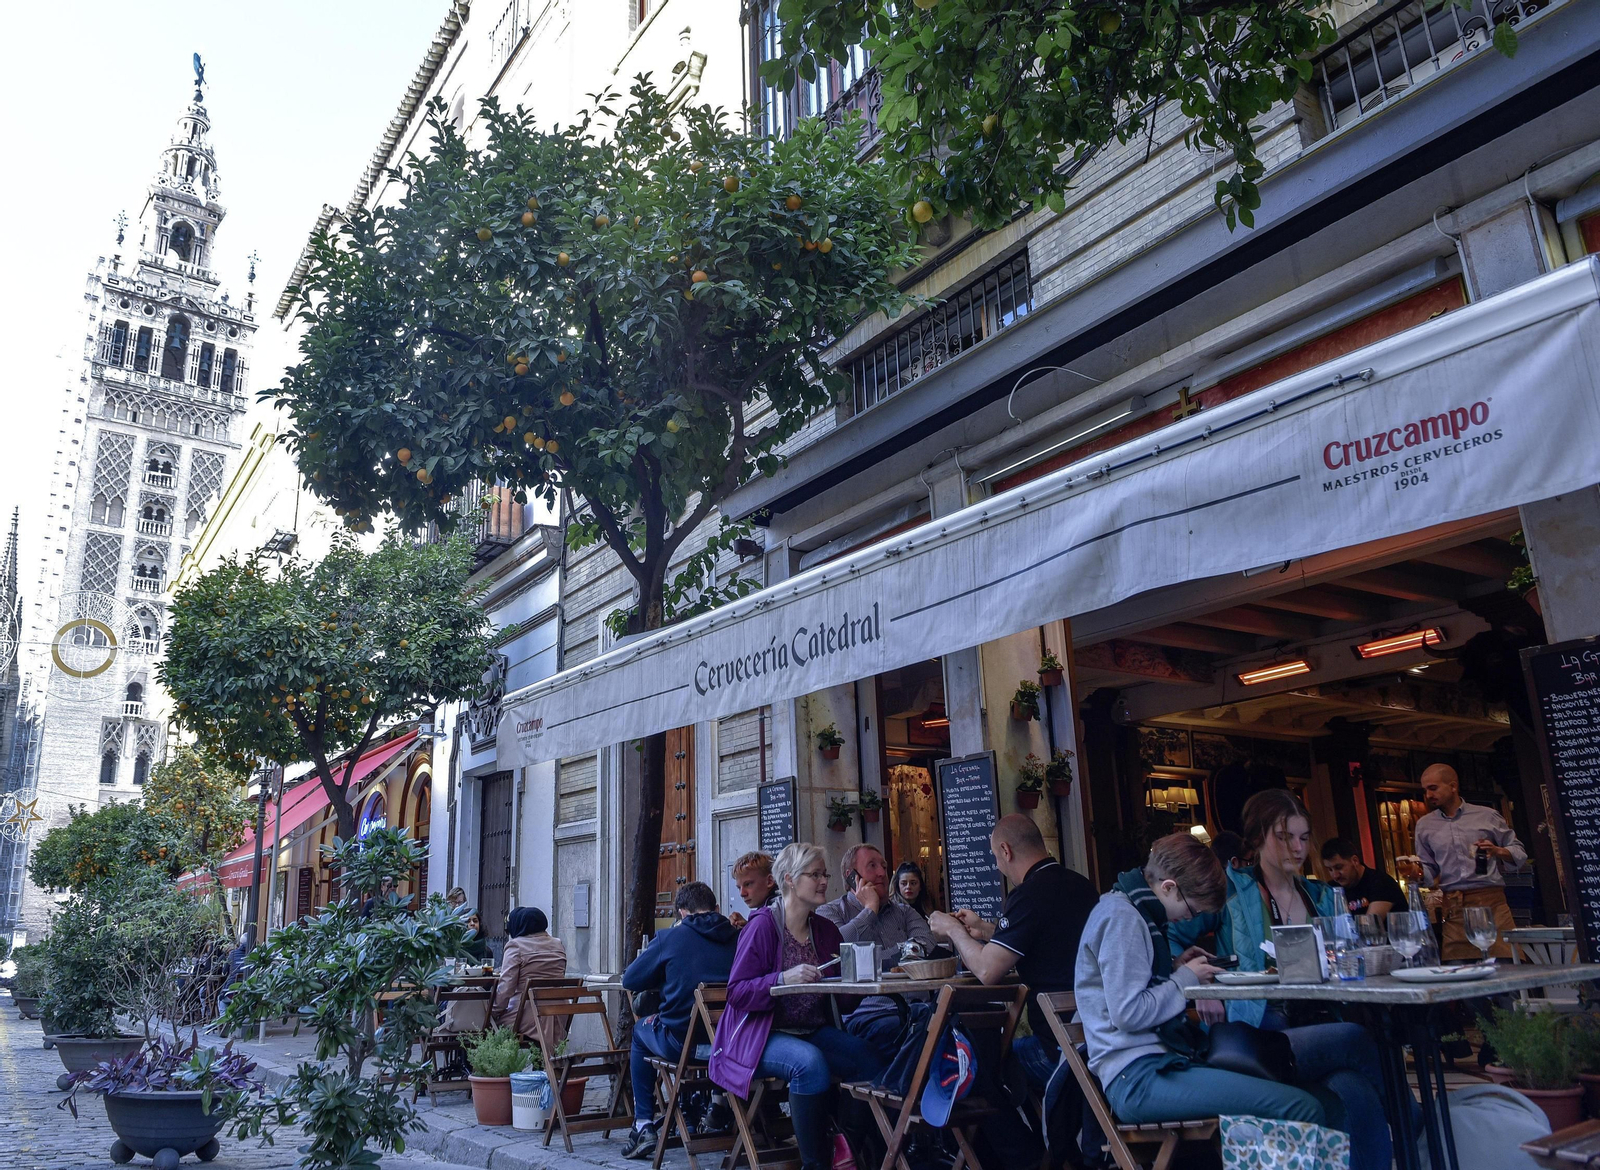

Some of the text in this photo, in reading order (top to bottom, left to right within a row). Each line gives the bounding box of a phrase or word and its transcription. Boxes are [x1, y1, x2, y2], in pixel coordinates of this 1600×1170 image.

[1323, 401, 1490, 470] Cruzcampo
[1323, 428, 1503, 492] MAESTROS CERVECEROS
[1395, 472, 1430, 491] 1904
[1401, 466, 1422, 477] DESDE
[694, 601, 881, 696] Cervecería Catedral
